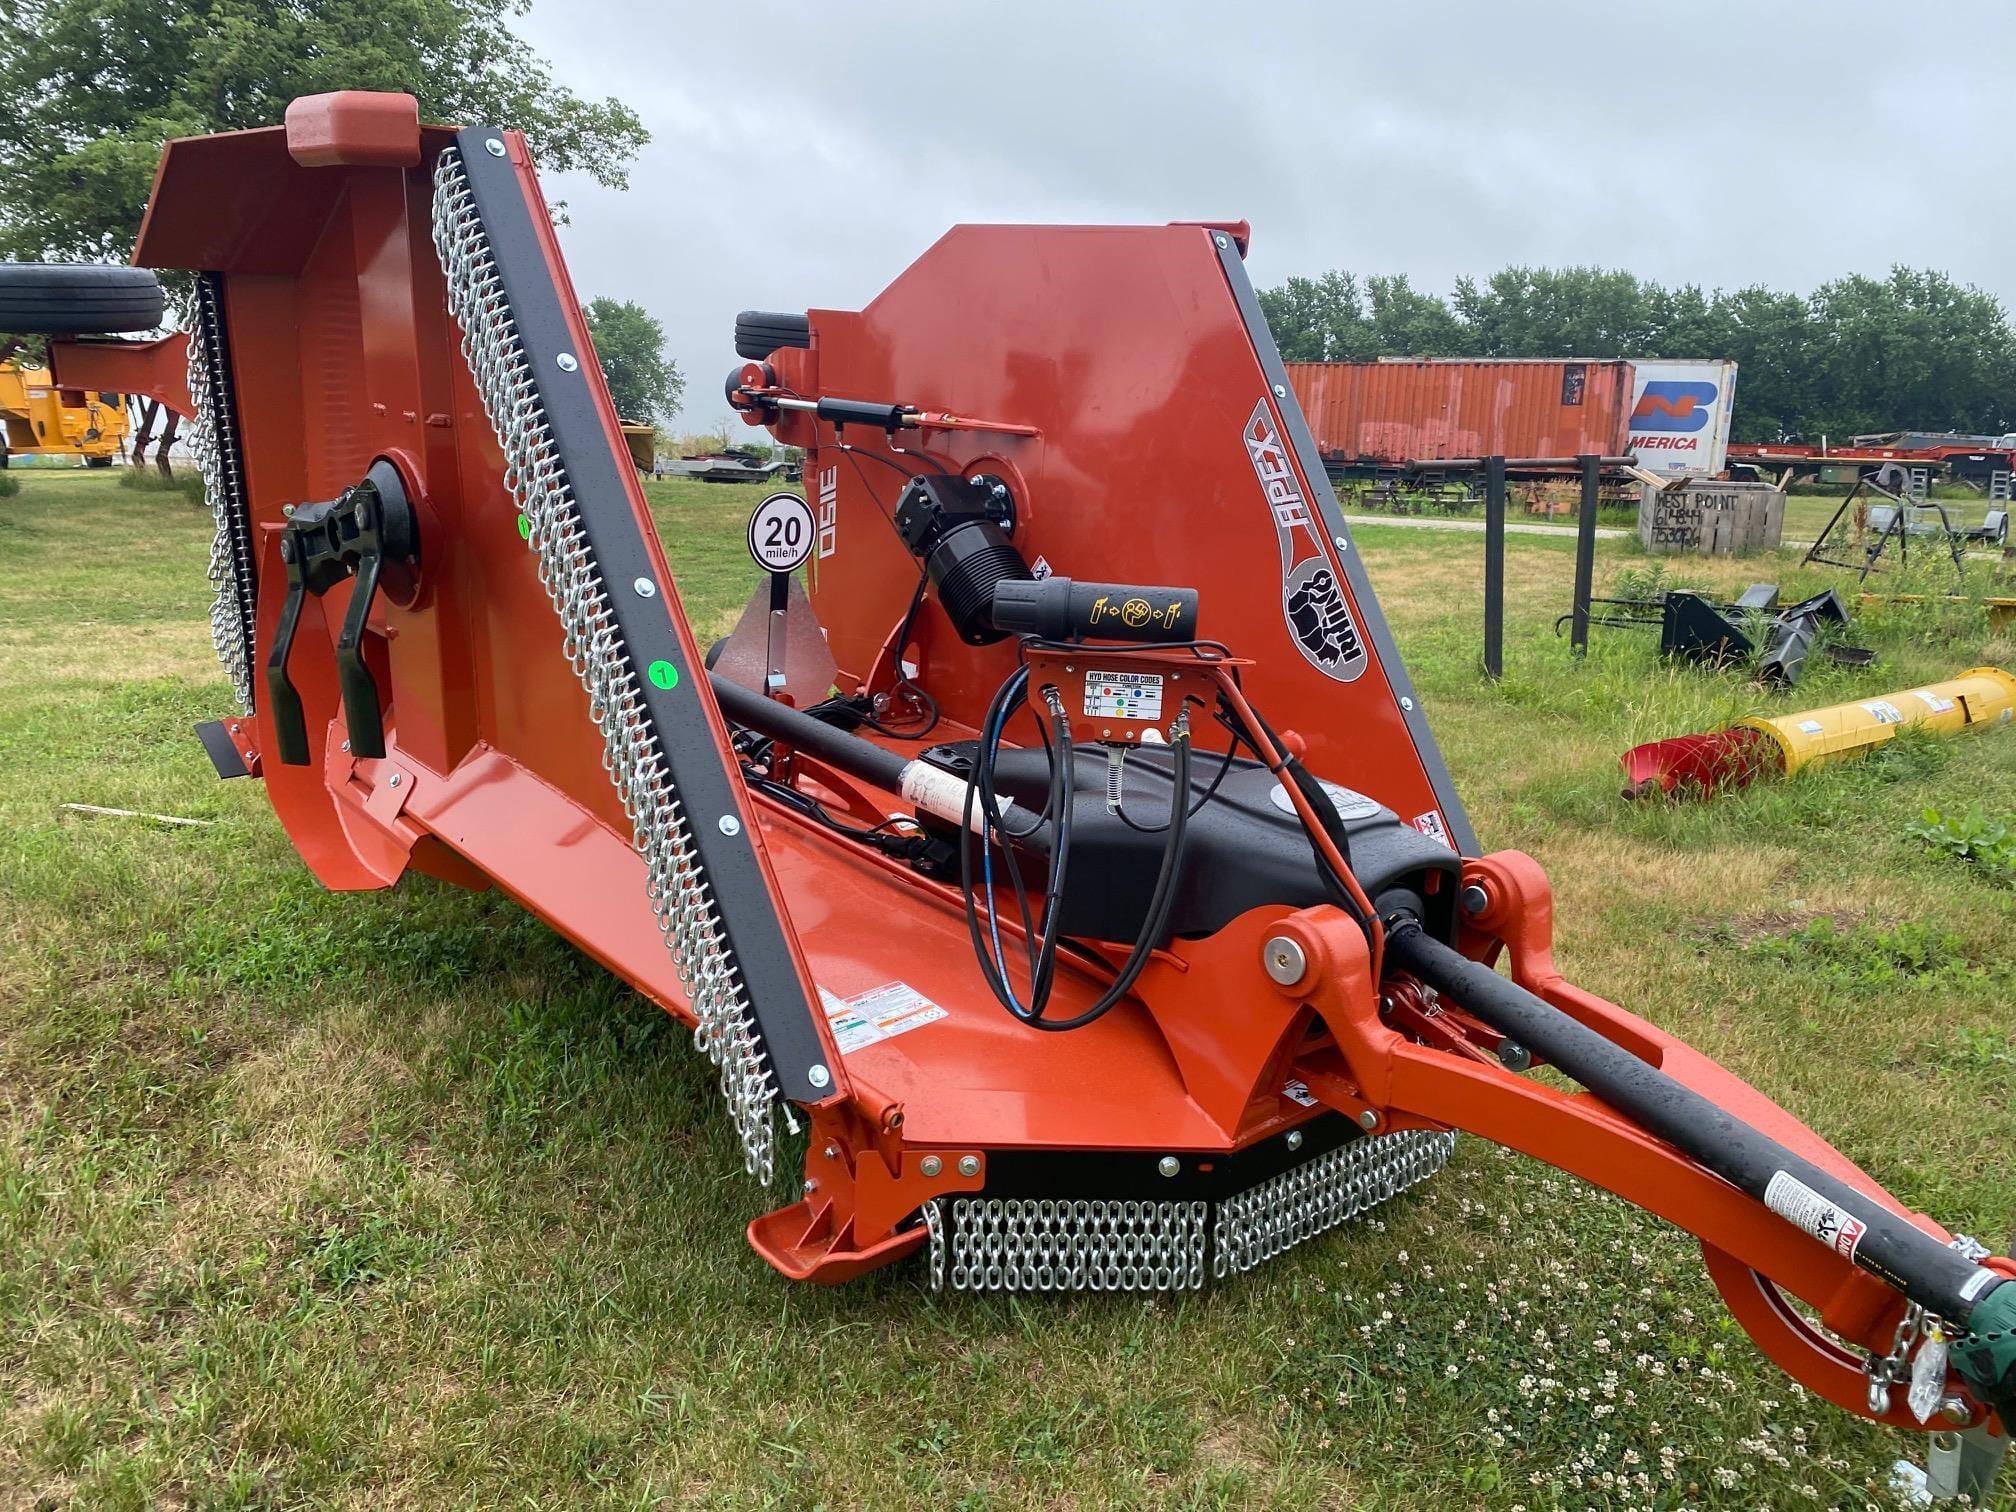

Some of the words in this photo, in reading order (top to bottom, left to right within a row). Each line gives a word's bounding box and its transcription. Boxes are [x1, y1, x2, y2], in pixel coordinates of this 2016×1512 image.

[1631, 436, 1698, 450] MERICA
[1247, 429, 1310, 528] APEX
[1655, 492, 1688, 510] WEST
[1695, 493, 1738, 511] POINT
[765, 517, 801, 546] 20
[766, 548, 798, 559] mile/h
[1312, 568, 1364, 665] RHINO
[657, 667, 668, 684] 1
[1089, 672, 1101, 681] HYD
[1103, 673, 1119, 682] HOSE
[1120, 675, 1140, 683] COLOR
[1140, 676, 1160, 684] CODES
